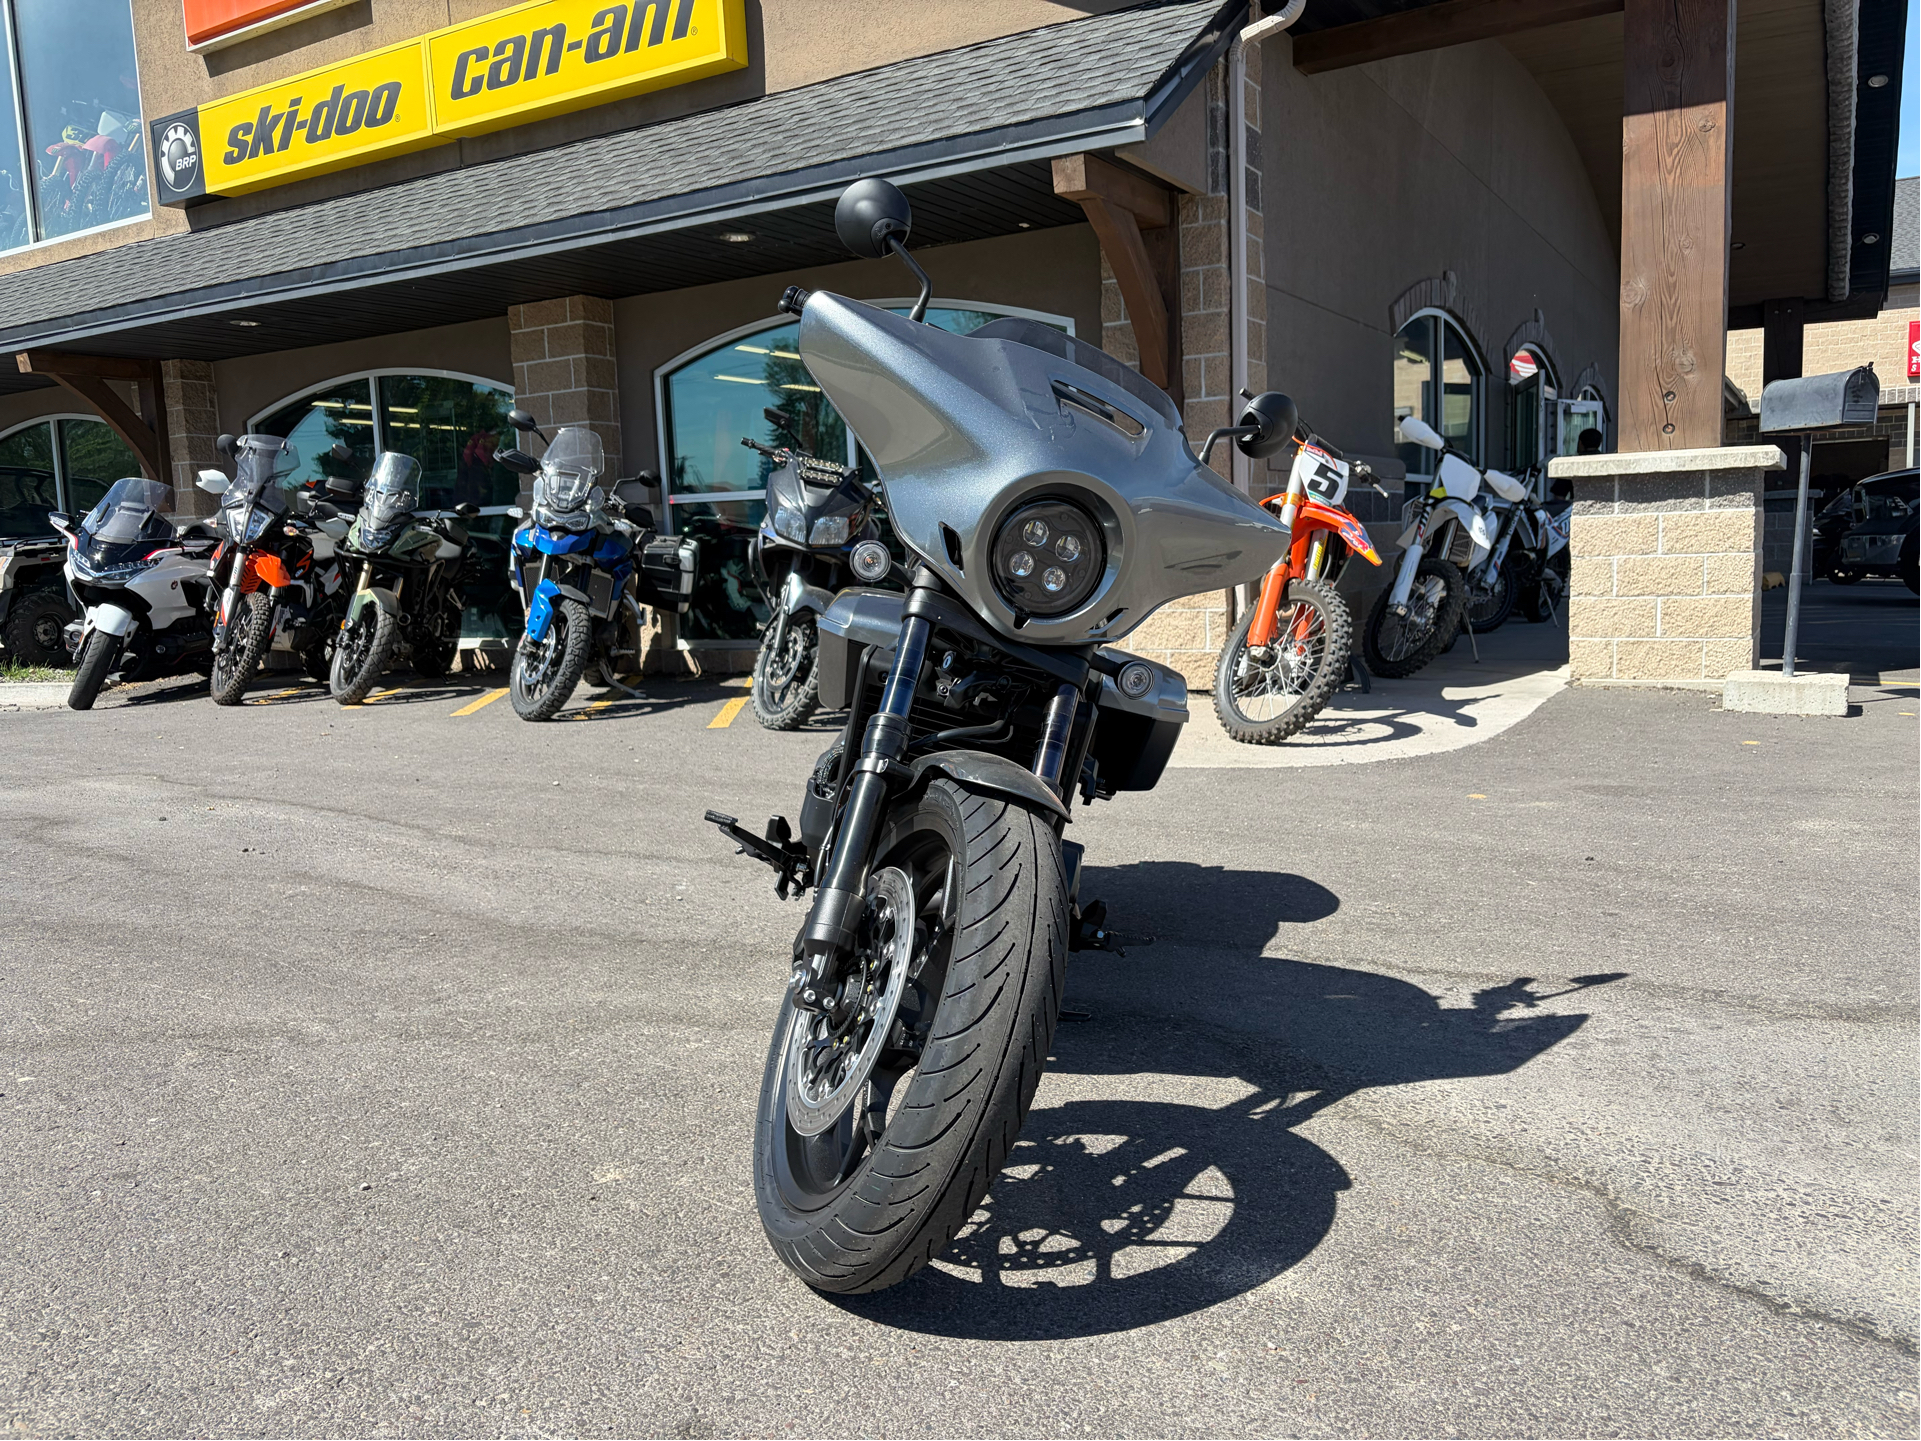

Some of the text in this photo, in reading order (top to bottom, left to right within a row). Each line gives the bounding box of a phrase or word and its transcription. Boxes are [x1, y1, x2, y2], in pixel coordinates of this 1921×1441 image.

[450, 0, 695, 101] can-am
[223, 81, 402, 166] ski-doo
[175, 154, 197, 171] BRP
[1306, 462, 1344, 501] 5
